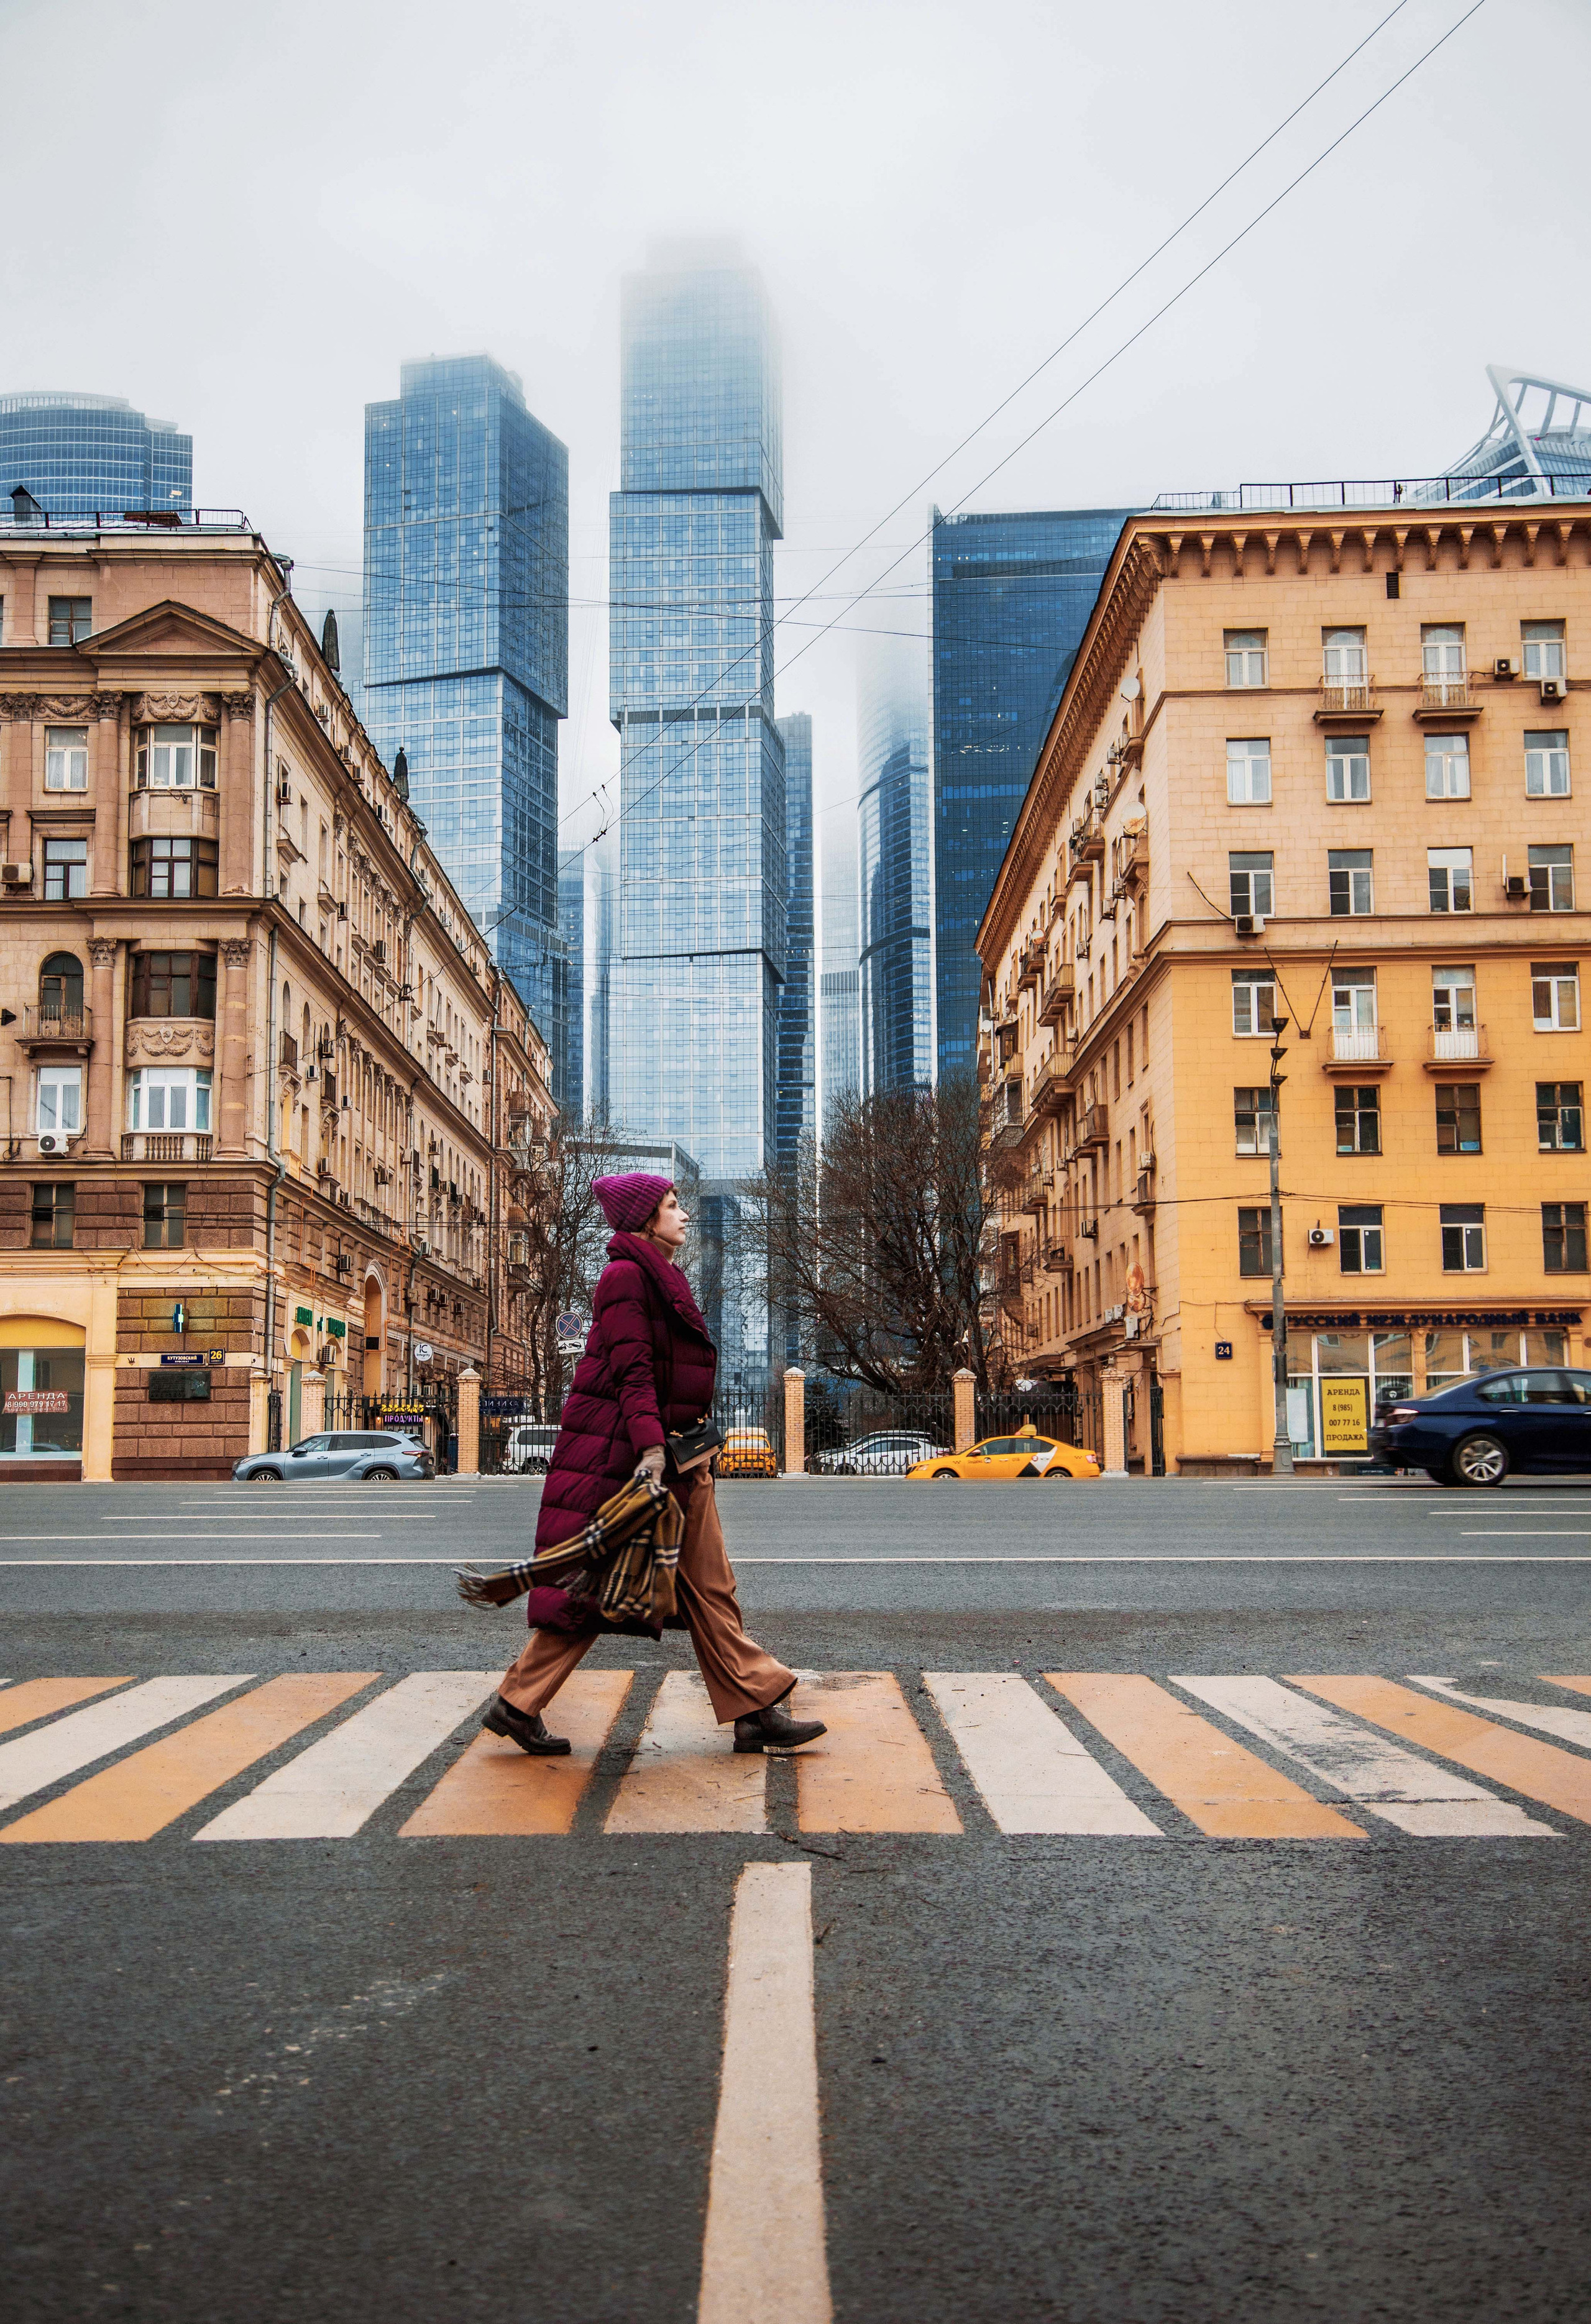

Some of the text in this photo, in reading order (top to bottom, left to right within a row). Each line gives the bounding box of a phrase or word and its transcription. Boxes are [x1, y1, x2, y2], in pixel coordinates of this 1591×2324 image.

[1367, 1311, 1529, 1327] МЕЖДУНАРОДНЫЙ
[1535, 1312, 1582, 1324] БАНК
[210, 1350, 222, 1360] 26
[1218, 1346, 1230, 1355] 24
[1337, 1404, 1353, 1412] (985)
